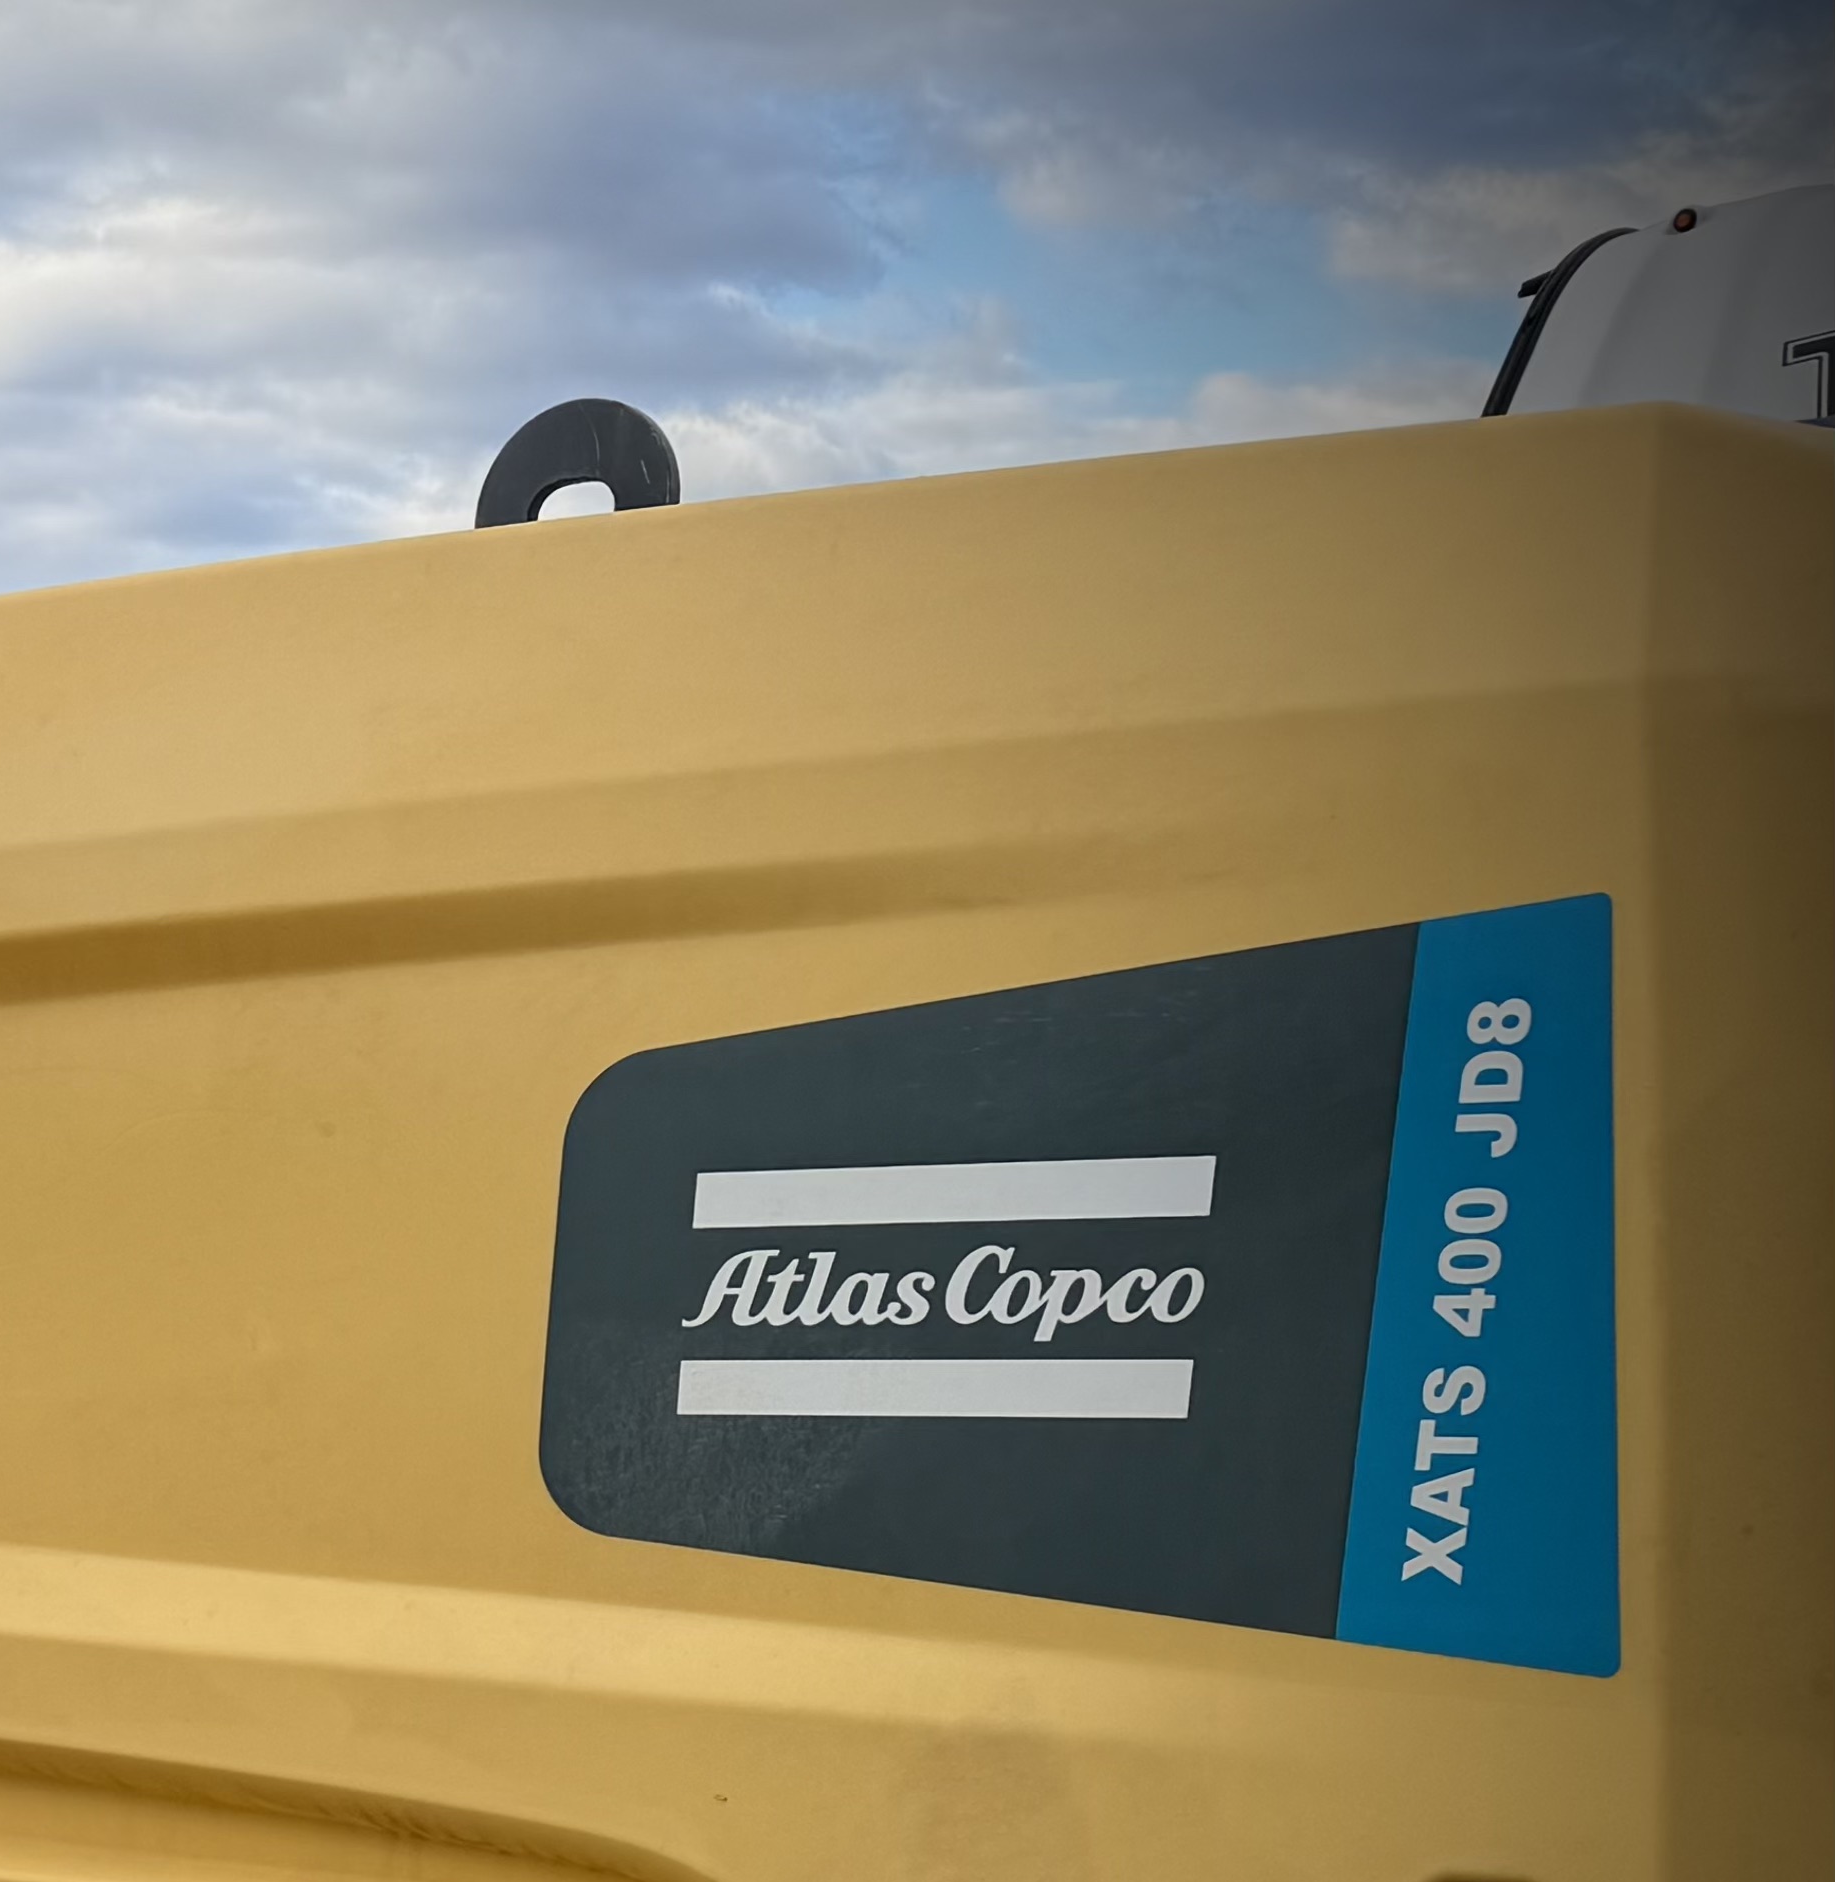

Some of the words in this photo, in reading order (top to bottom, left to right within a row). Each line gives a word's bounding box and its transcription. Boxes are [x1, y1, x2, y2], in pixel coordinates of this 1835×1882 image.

[1455, 997, 1533, 1159] JD8
[681, 1249, 937, 1329] Atlas
[943, 1244, 1206, 1343] Copco
[1432, 1187, 1509, 1339] 400
[1401, 1365, 1487, 1586] XATS
